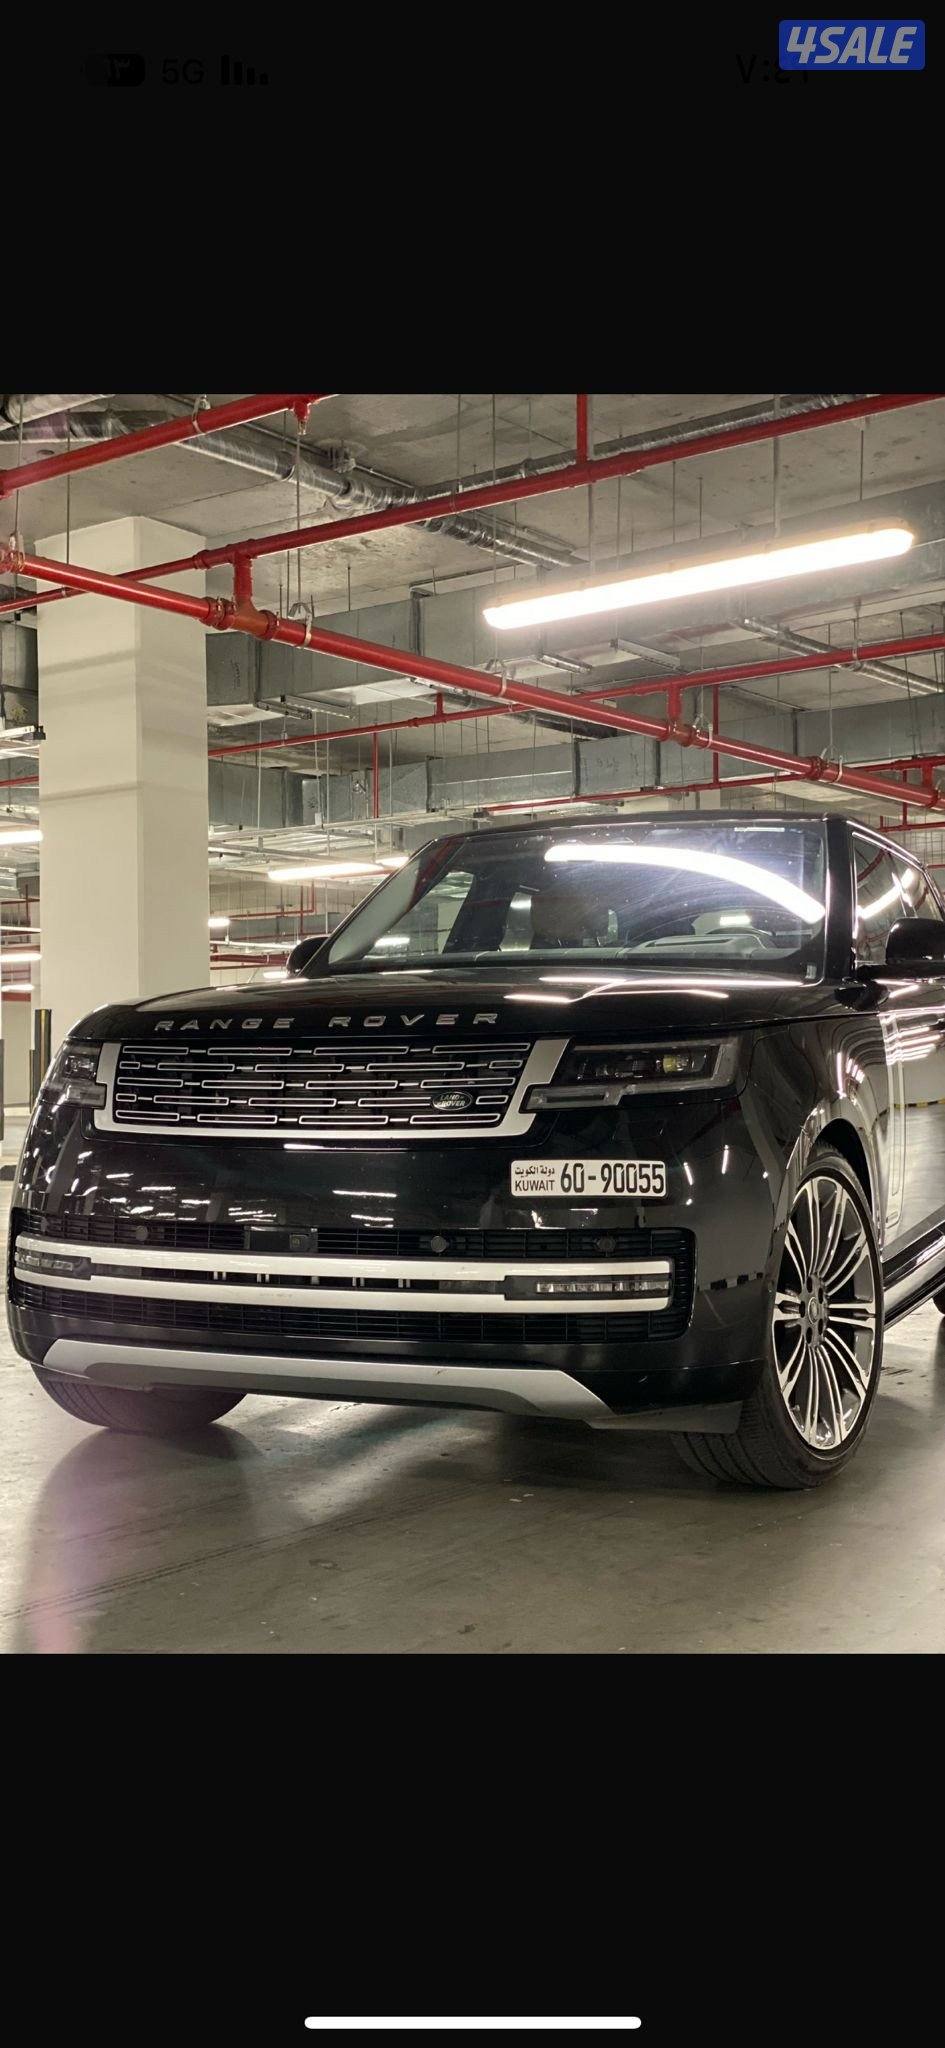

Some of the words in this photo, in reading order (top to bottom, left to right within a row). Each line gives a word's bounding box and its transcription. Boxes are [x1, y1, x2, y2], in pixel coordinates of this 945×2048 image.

[154, 1016, 296, 1032] RANGE
[327, 1012, 499, 1029] ROVER
[514, 1165, 539, 1178] الكويت
[540, 1164, 556, 1178] دولة
[560, 1162, 665, 1194] 60-90055
[514, 1180, 556, 1192] KUWAIT
